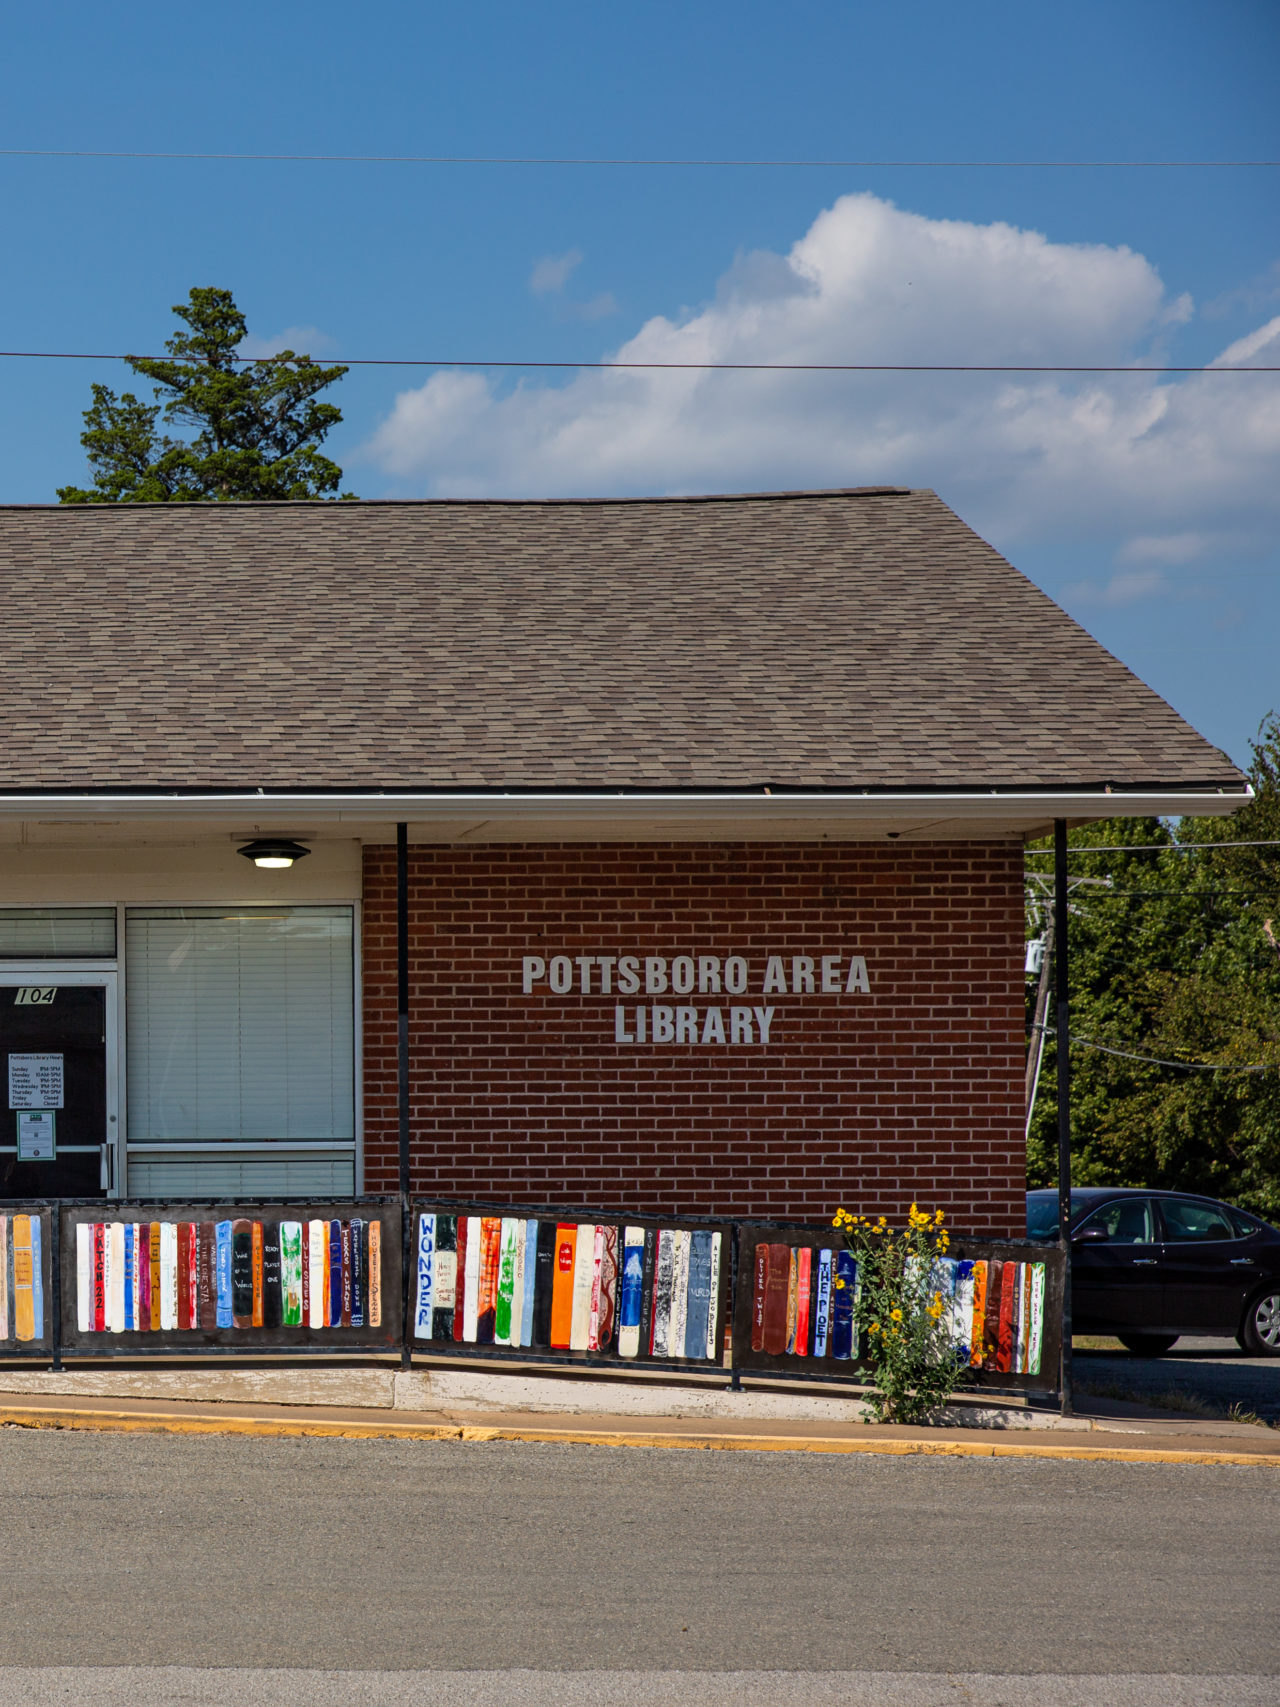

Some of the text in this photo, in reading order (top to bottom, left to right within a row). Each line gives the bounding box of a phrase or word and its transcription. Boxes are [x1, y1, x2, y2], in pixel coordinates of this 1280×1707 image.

[20, 988, 54, 1003] 104
[522, 955, 871, 994] POTTSBORO AREA
[614, 1005, 776, 1044] LIBRARY
[95, 1228, 104, 1309] CATCH 22
[341, 1229, 350, 1265] TEXAS
[419, 1218, 433, 1327] WONDER
[642, 1232, 655, 1335] DIVINE COMEDY
[816, 1262, 830, 1347] THE POET
